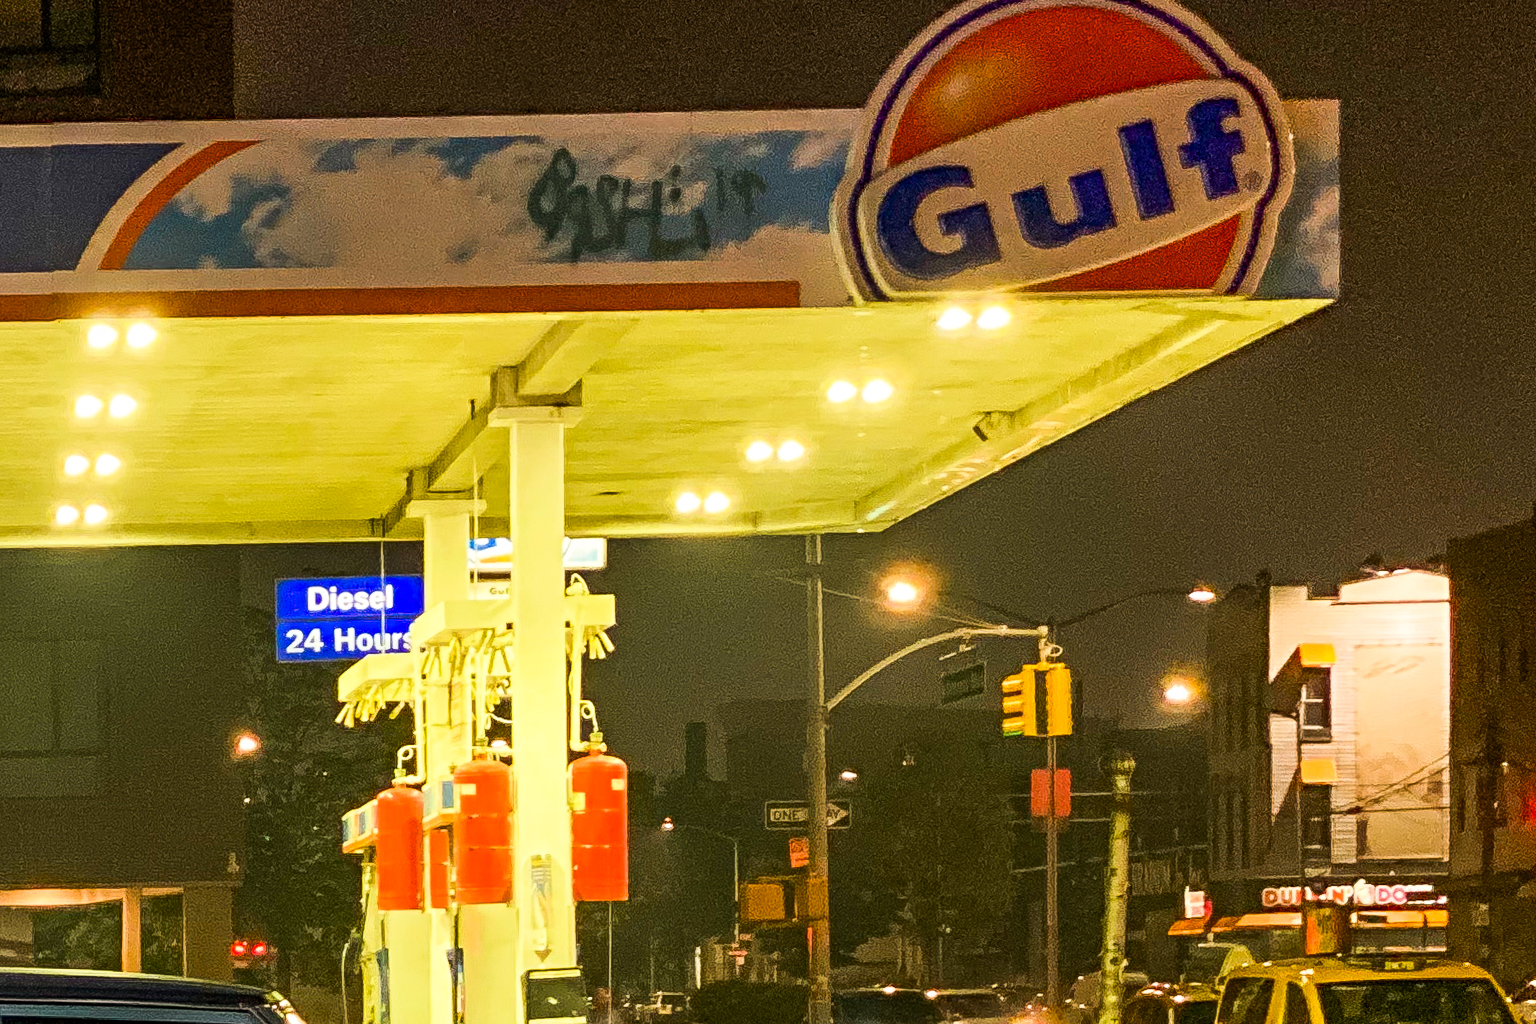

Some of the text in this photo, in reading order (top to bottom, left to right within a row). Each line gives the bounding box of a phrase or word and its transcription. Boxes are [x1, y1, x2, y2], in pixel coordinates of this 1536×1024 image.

[876, 97, 1246, 281] Gulf
[307, 584, 394, 612] Diesel
[285, 627, 412, 654] 24 Hours
[773, 809, 800, 820] ONE
